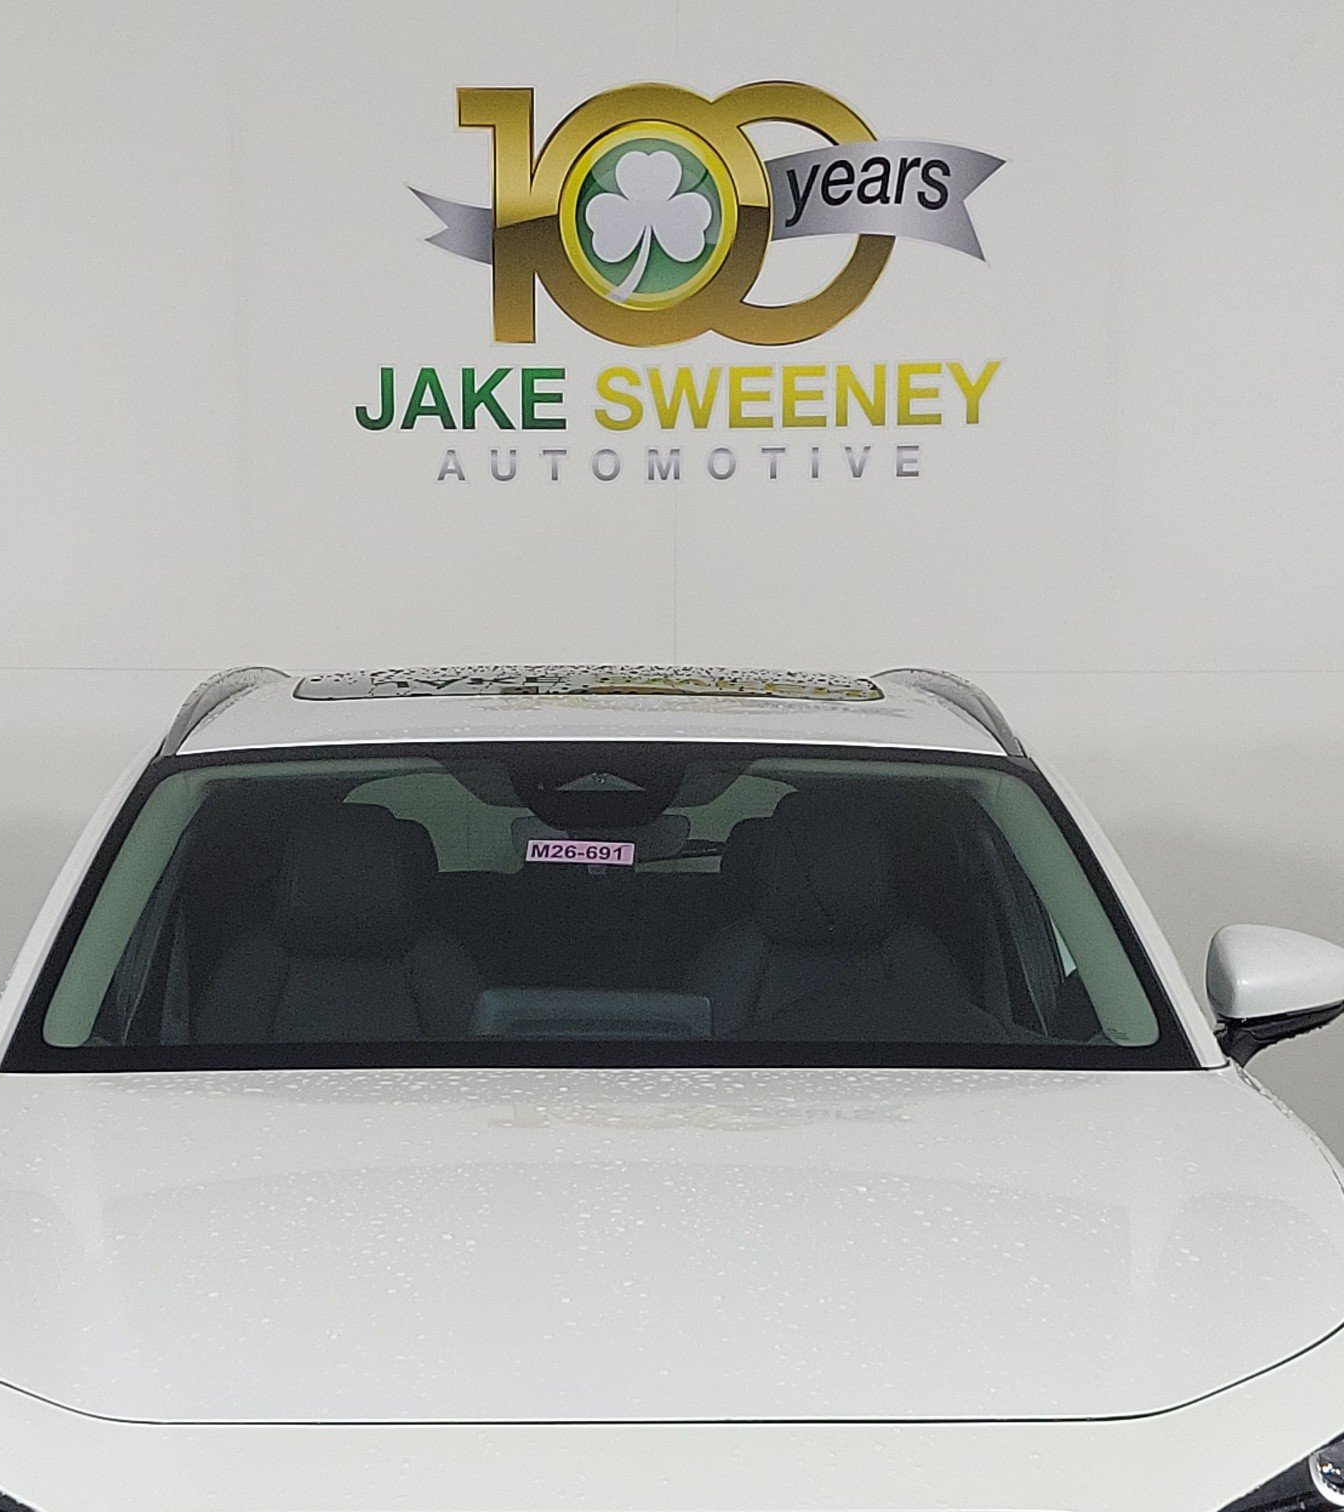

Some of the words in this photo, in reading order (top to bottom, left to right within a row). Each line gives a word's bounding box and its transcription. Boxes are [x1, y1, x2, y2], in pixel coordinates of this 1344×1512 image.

[457, 80, 894, 347] 100
[785, 156, 952, 227] years
[355, 366, 567, 431] JAKE
[595, 361, 1000, 430] SWEENEY
[437, 444, 921, 482] AUTOMOTIVE
[530, 844, 623, 860] M26-691
